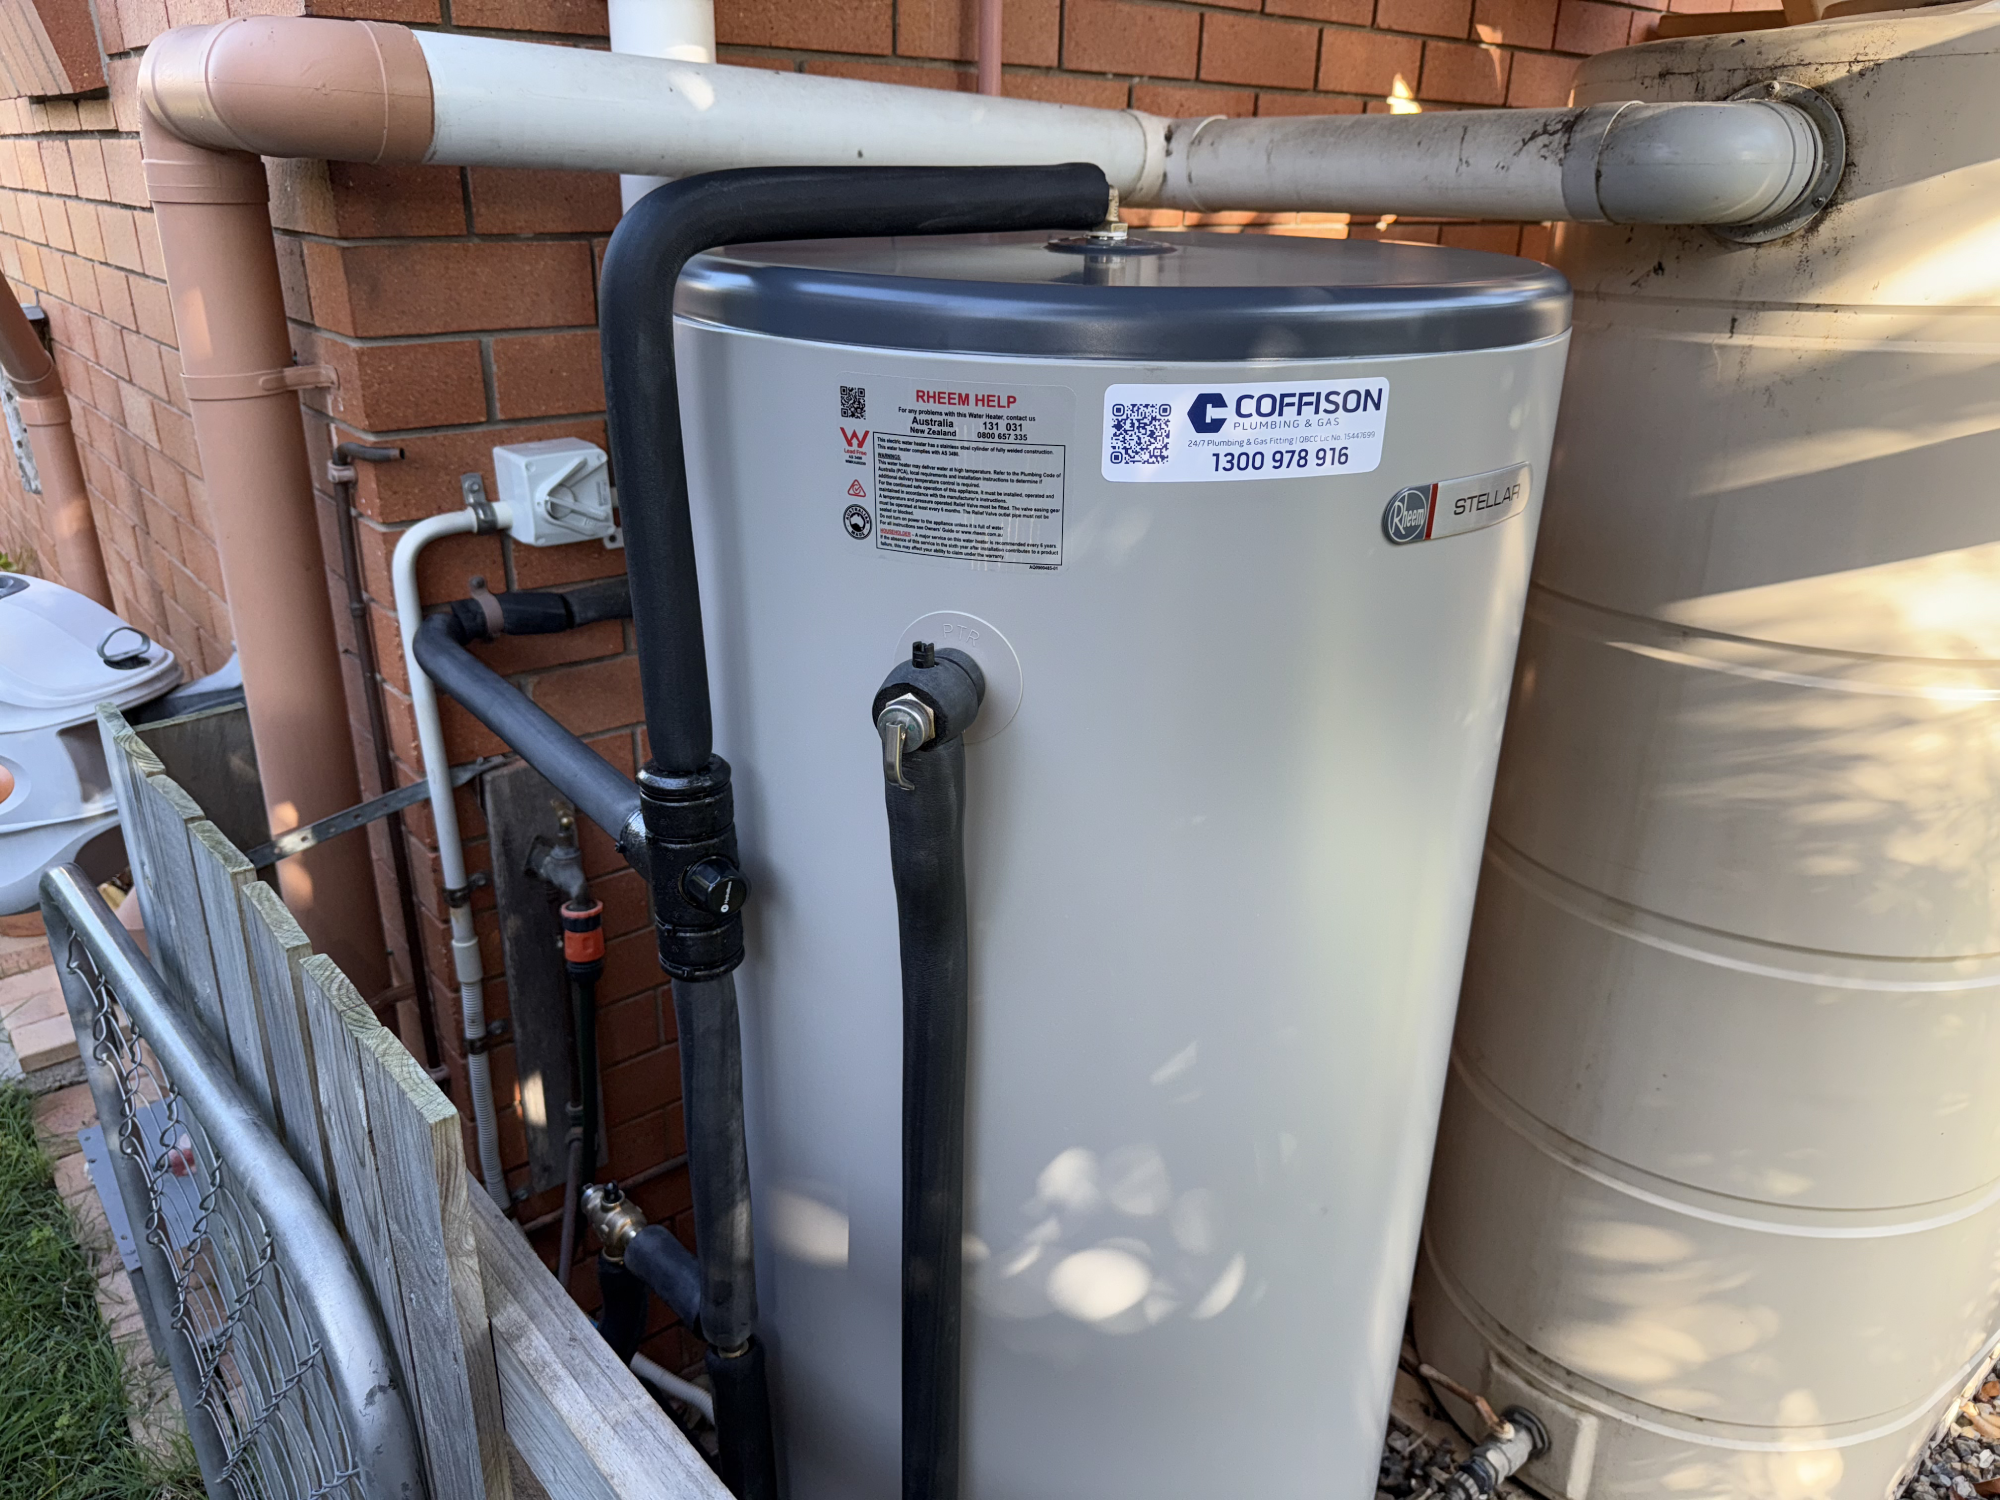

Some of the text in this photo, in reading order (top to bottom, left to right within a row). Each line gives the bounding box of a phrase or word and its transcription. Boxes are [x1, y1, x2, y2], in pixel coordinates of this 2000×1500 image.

[916, 389, 1017, 408] RHEEM HELP
[1235, 388, 1383, 418] COFFISON
[912, 416, 1022, 432] Australia 131 031
[918, 409, 943, 417] problems
[944, 410, 956, 418] with
[985, 413, 1004, 421] Heater,
[1006, 414, 1028, 422] contact
[1234, 417, 1340, 430] PLUMBING & GAS
[910, 426, 925, 434] New
[927, 428, 956, 437] Zealand
[977, 431, 996, 440] 0800
[998, 432, 1012, 440] 657
[1188, 440, 1206, 448] 24/7
[1207, 438, 1244, 448] Plumbing
[1246, 438, 1252, 446] &
[1254, 438, 1268, 446] Gas
[1269, 437, 1294, 445] Fitting
[1298, 435, 1318, 443] QBCC
[1212, 446, 1349, 472] 1300 978 916
[1454, 484, 1520, 516] STELLAR
[1392, 493, 1424, 534] Rheem
[942, 624, 980, 647] PTR
